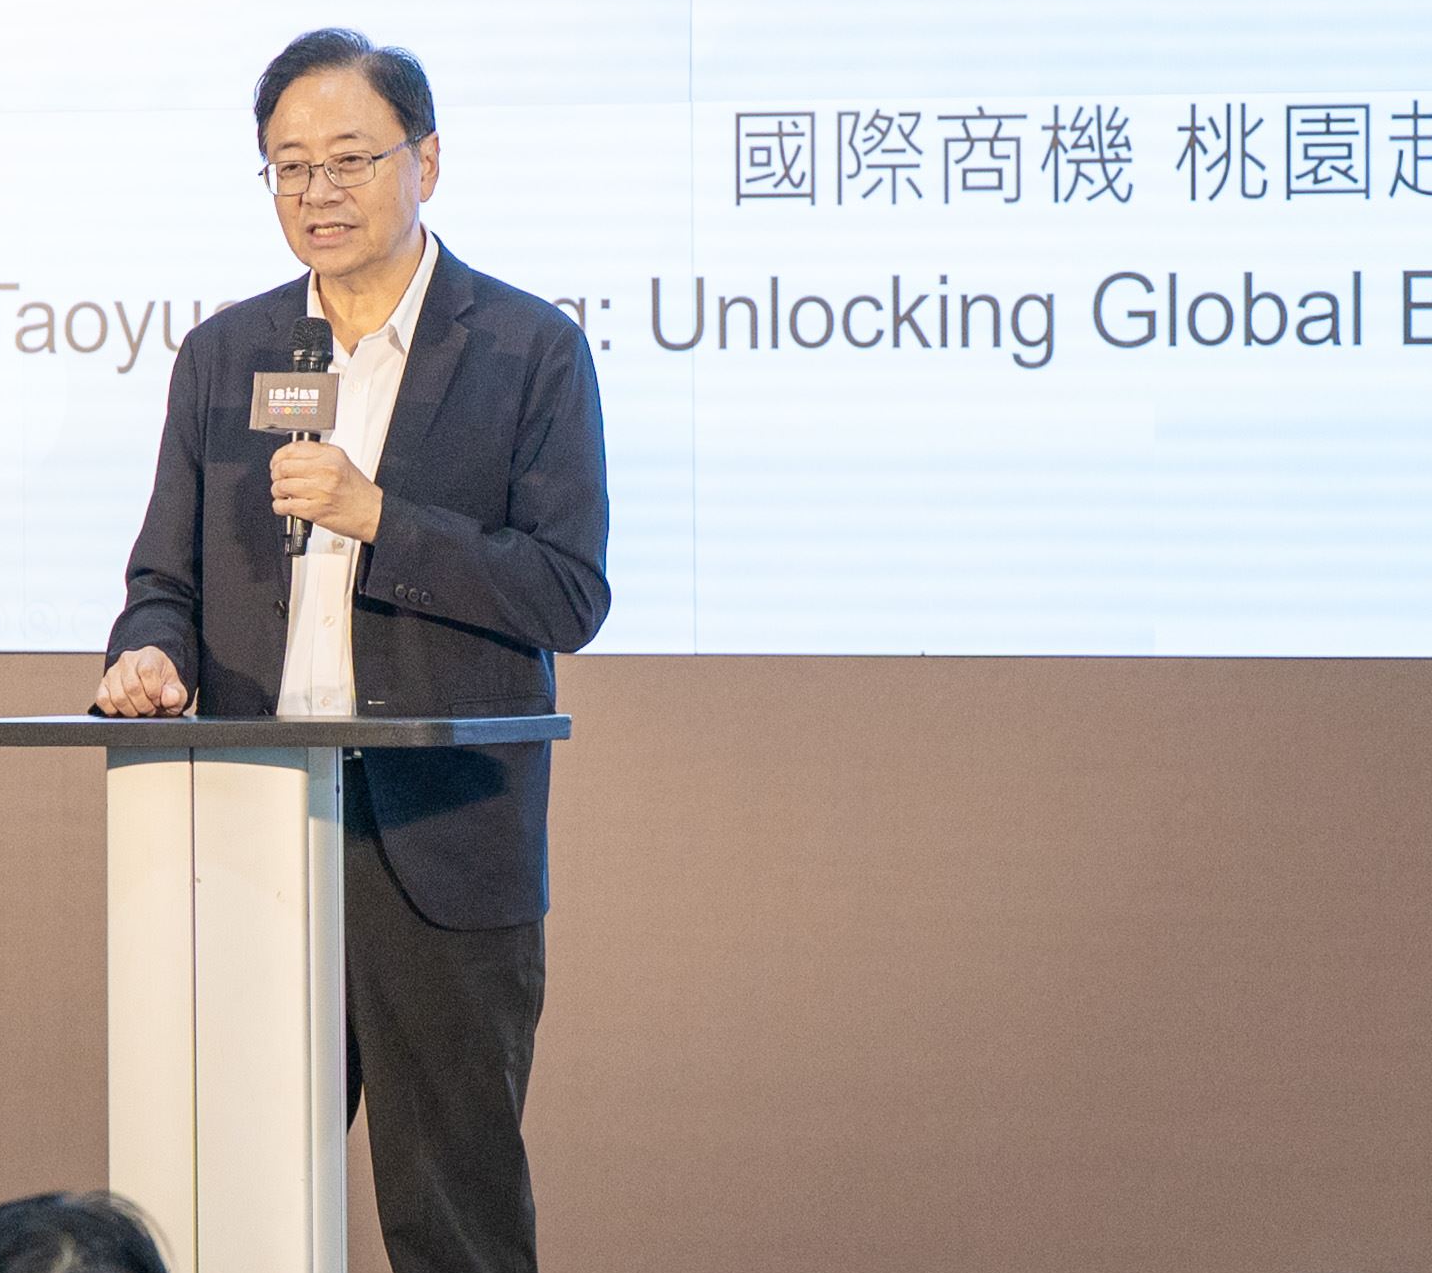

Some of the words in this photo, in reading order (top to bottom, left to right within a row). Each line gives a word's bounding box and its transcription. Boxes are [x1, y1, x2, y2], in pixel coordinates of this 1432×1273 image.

[736, 104, 1134, 206] 國際商機
[651, 274, 1055, 370] Unlocking
[1092, 271, 1363, 350] Global
